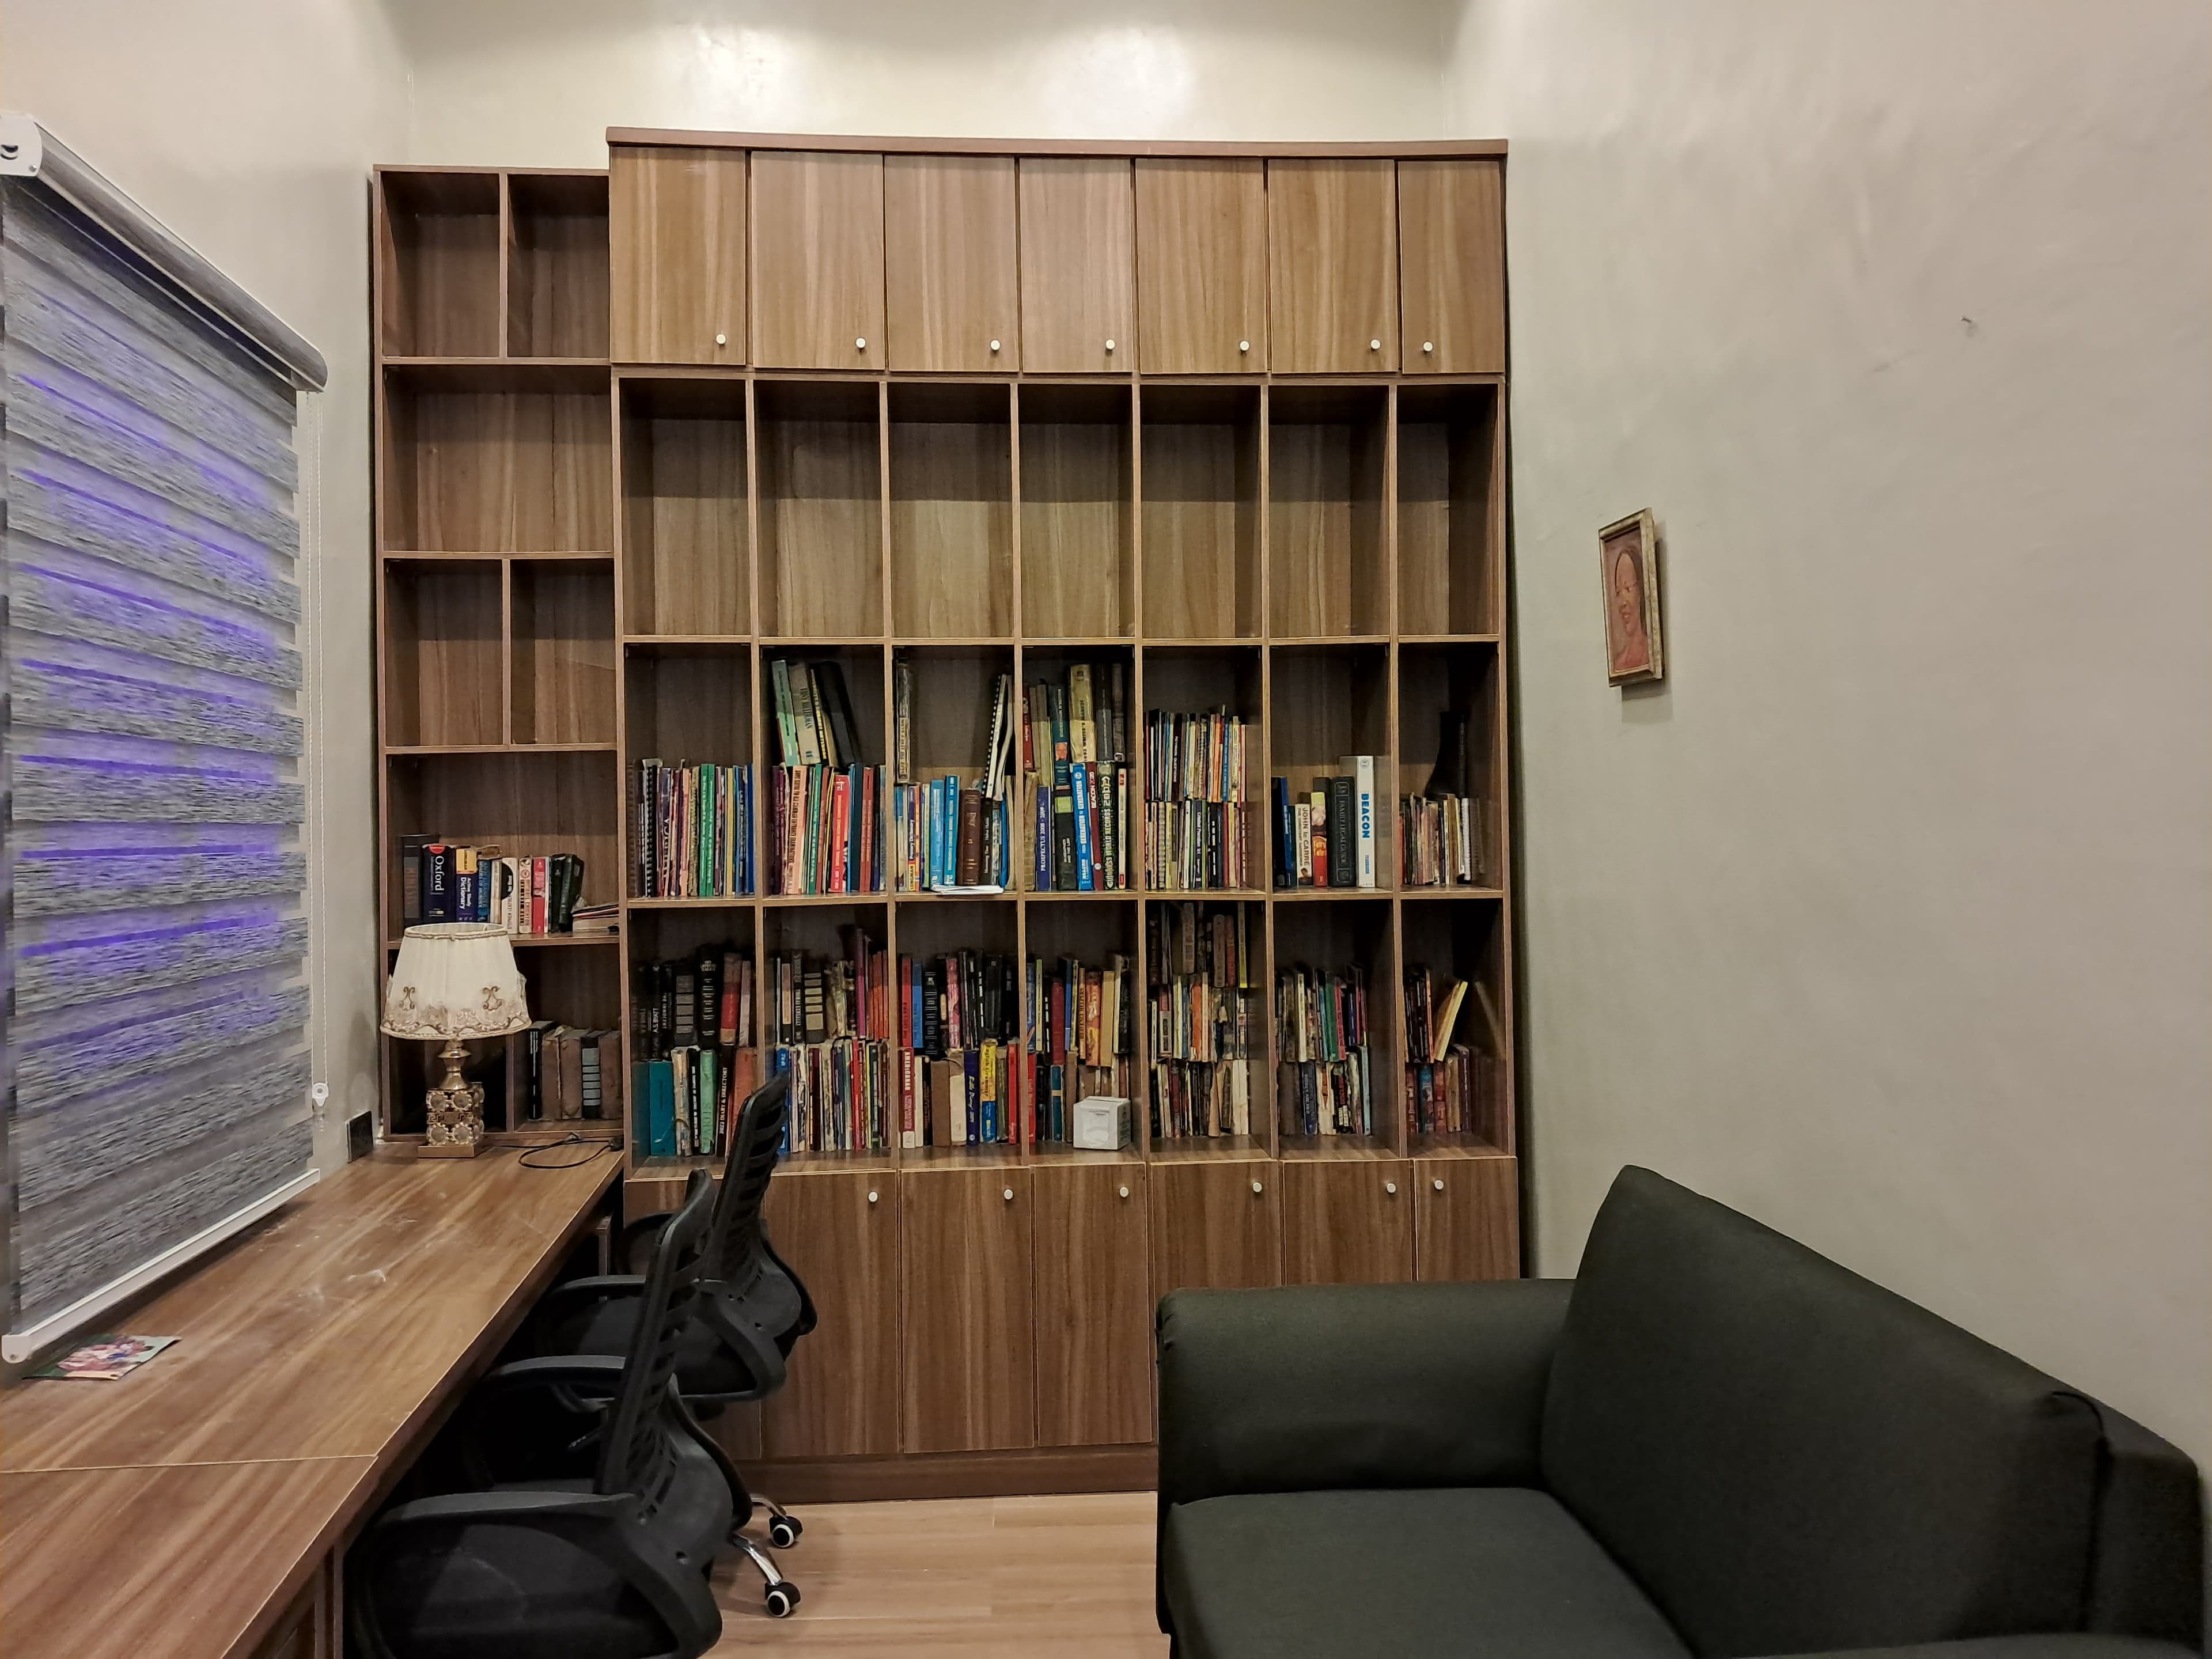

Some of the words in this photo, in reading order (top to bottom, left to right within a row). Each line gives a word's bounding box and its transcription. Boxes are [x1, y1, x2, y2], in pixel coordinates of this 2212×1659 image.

[1361, 793, 1370, 839] BEACON
[434, 855, 445, 891] Oxford
[1104, 857, 1114, 888] GUINNESS
